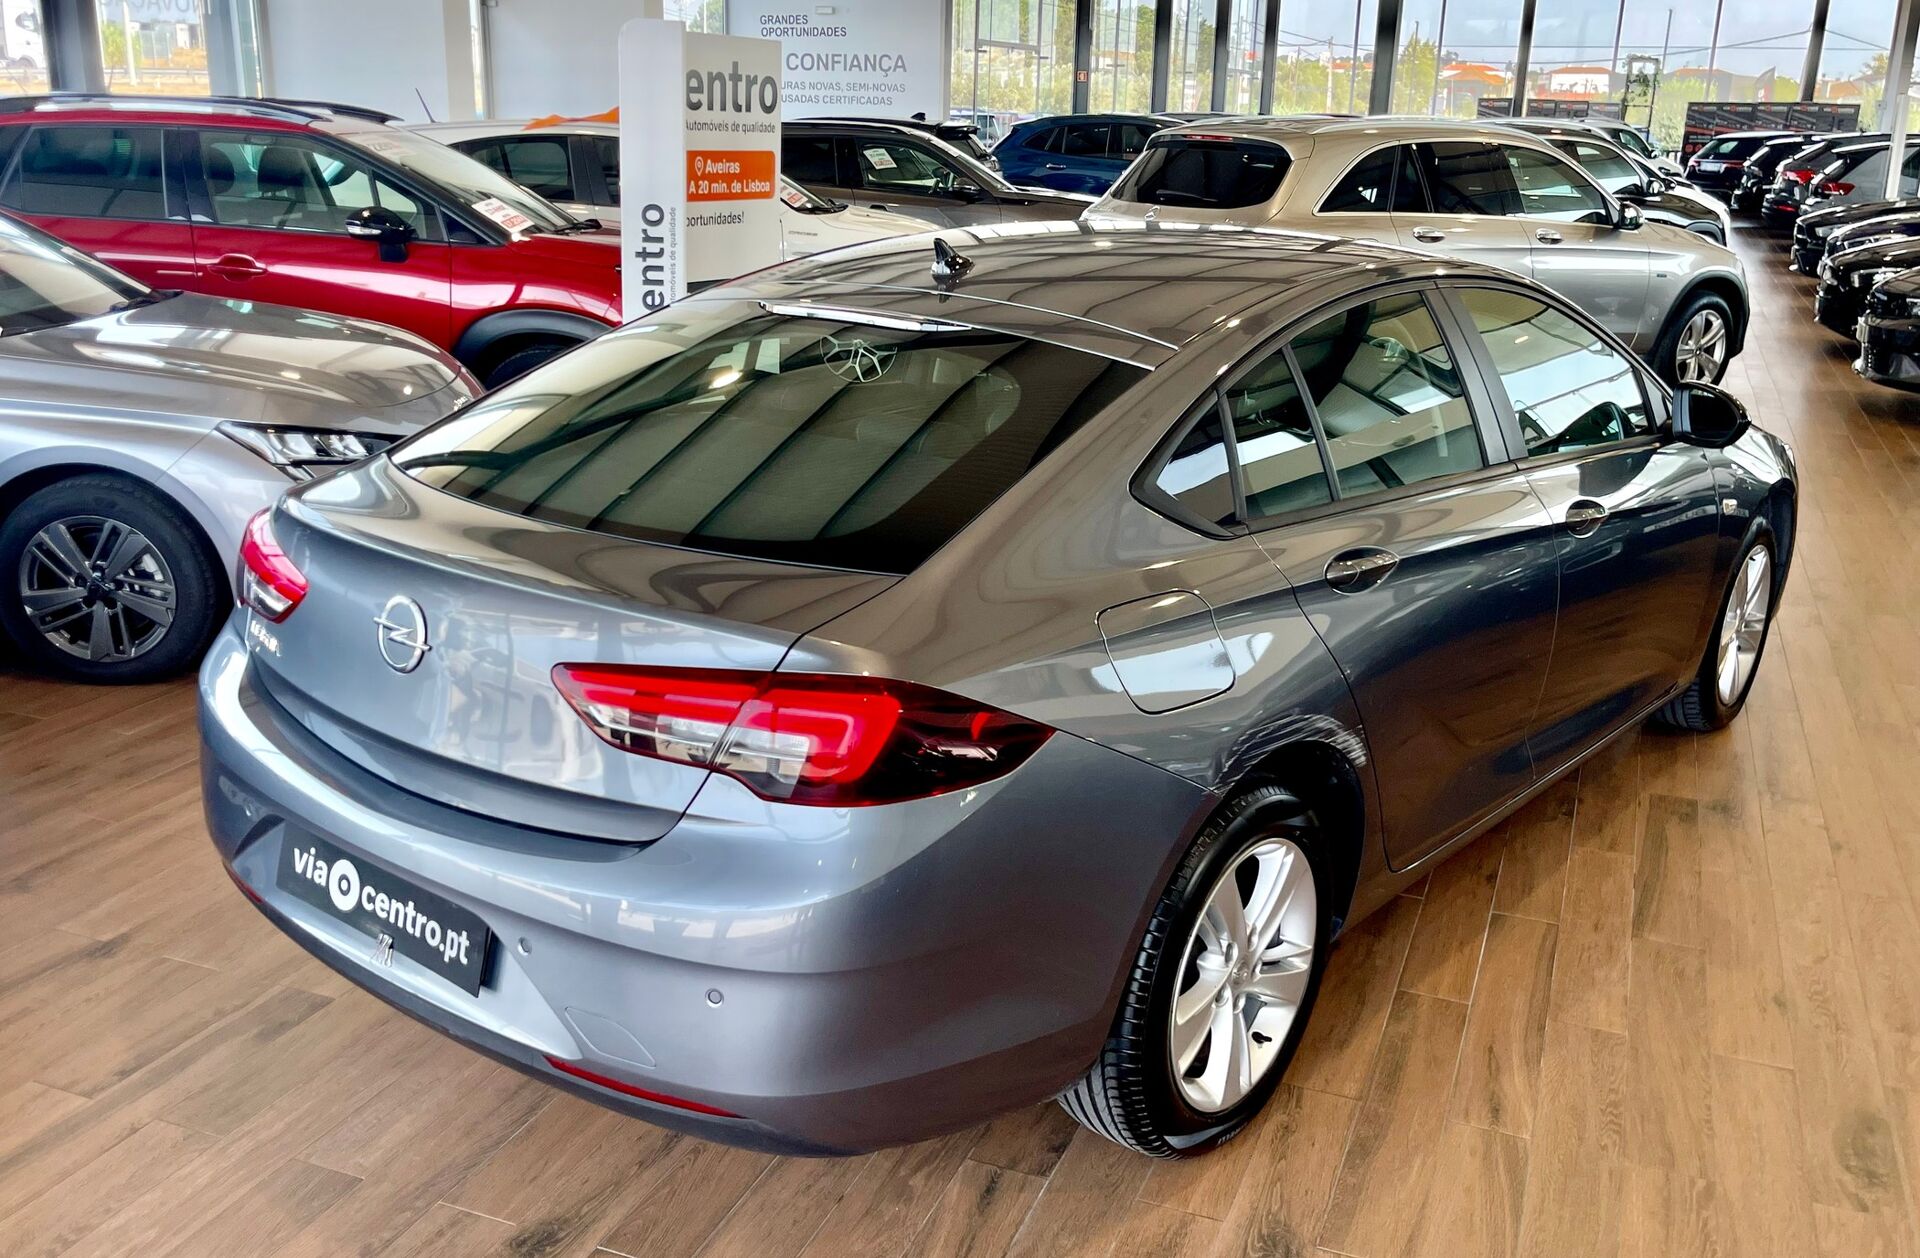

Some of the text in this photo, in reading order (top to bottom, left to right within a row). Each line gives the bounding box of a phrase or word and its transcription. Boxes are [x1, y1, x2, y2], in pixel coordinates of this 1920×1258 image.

[760, 15, 808, 25] GRANDES
[761, 27, 847, 37] OPORTUNIDADES
[786, 53, 907, 78] CONFIANÇA
[685, 61, 778, 115] entro
[808, 82, 843, 92] NOVAS,
[845, 82, 906, 93] SEMI-NOVAS
[781, 94, 893, 106] USADAS CERTIFICADAS
[730, 121, 740, 132] de
[741, 122, 776, 135] qualidade
[705, 159, 740, 174] Aveiras
[688, 179, 770, 194] A 20 min. de Lisboa
[669, 206, 678, 248] qualidade
[635, 203, 665, 312] entro
[293, 847, 470, 966] via centro.pt
